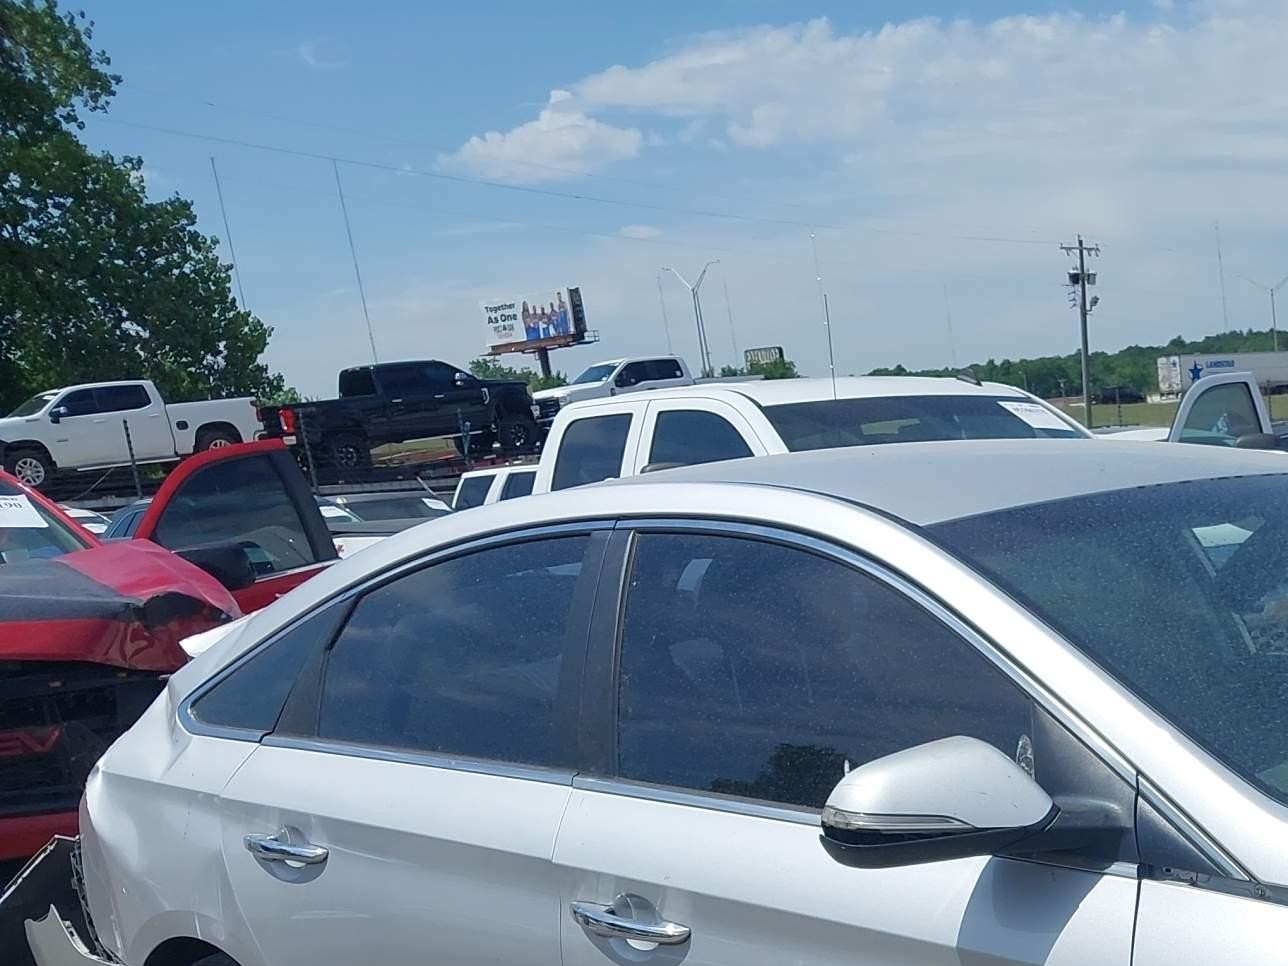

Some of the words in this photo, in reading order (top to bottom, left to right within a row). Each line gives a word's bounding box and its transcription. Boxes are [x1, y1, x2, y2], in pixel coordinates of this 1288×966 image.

[484, 303, 516, 314] Together
[487, 315, 499, 325] As
[500, 313, 518, 323] One
